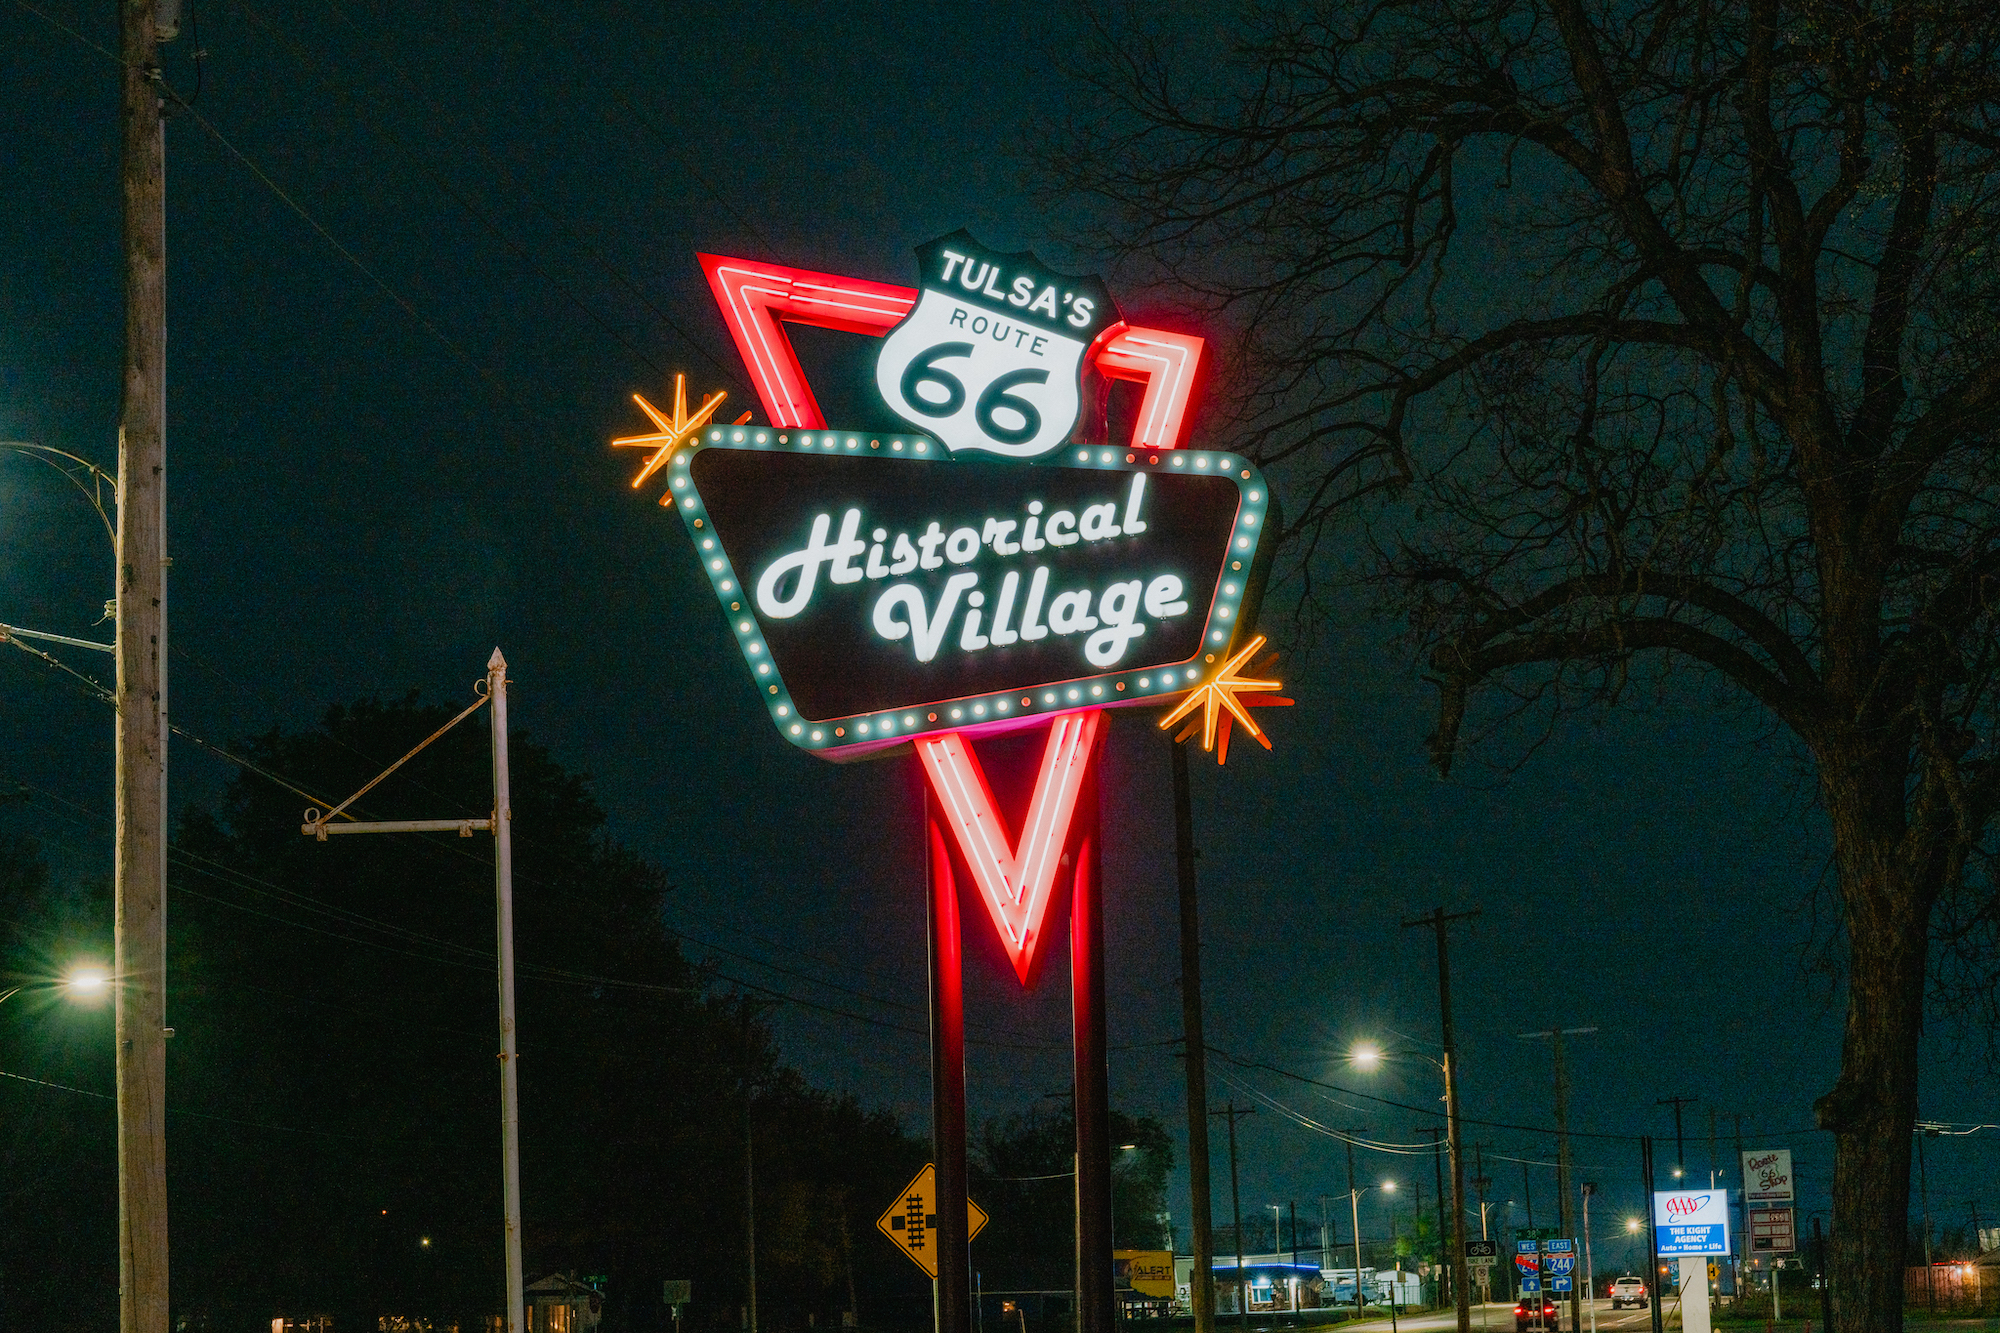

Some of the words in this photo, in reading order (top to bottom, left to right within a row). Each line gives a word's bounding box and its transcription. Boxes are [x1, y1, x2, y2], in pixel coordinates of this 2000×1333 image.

[941, 249, 1095, 328] TULSA'S
[949, 307, 1049, 357] ROUTE
[899, 341, 1051, 446] 66
[756, 471, 1148, 619] Historical
[872, 566, 1189, 668] Village
[1748, 1154, 1779, 1172] Route
[1761, 1169, 1776, 1178] 66
[1669, 1197, 1696, 1215] AAA
[1669, 1227, 1685, 1235] THE
[1686, 1226, 1711, 1235] KIGHT
[1674, 1235, 1707, 1243] AGENCY
[1551, 1258, 1570, 1271] 244
